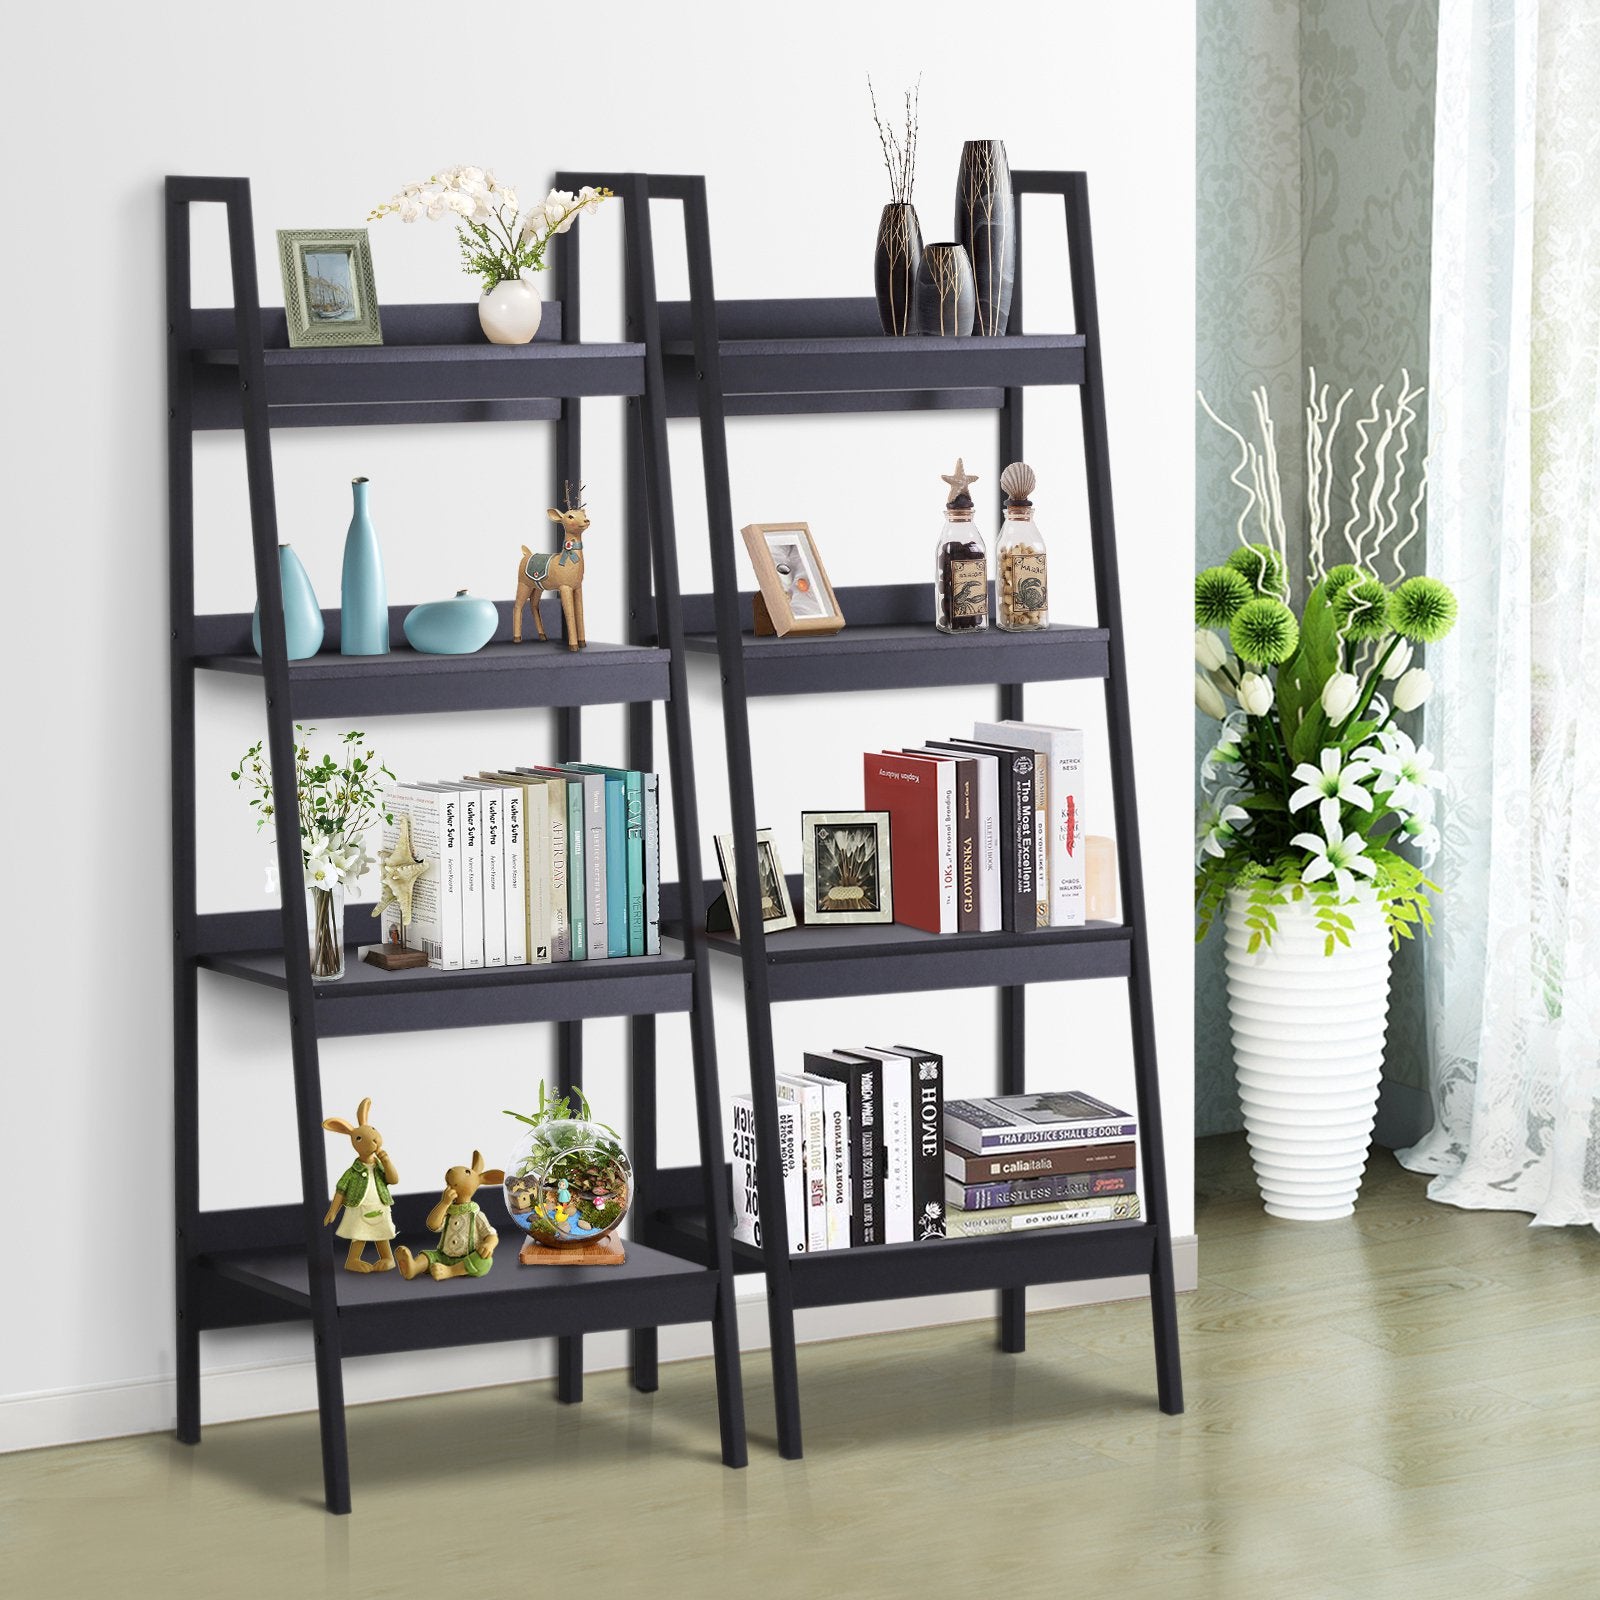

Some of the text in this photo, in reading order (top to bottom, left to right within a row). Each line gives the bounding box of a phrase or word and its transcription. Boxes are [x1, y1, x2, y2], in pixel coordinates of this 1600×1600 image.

[900, 773, 920, 784] Kaplan
[627, 789, 642, 840] LOVE
[490, 826, 498, 845] Sutra
[1022, 780, 1032, 893] The Most Excellent
[553, 822, 564, 889] AFTER DAYS
[944, 865, 953, 889] 10Ks
[633, 896, 643, 941] MERRITT
[999, 1126, 1123, 1144] THAT JUSTICE SHALL BE DONE
[1003, 1160, 1053, 1173] caliaitalia
[997, 1187, 1052, 1203] RESTLESS
[1055, 1182, 1089, 1196] EARTH
[964, 1218, 1008, 1228] SIDESHOW
[1042, 1215, 1059, 1223] YOU
[1061, 1213, 1079, 1221] LIKE
